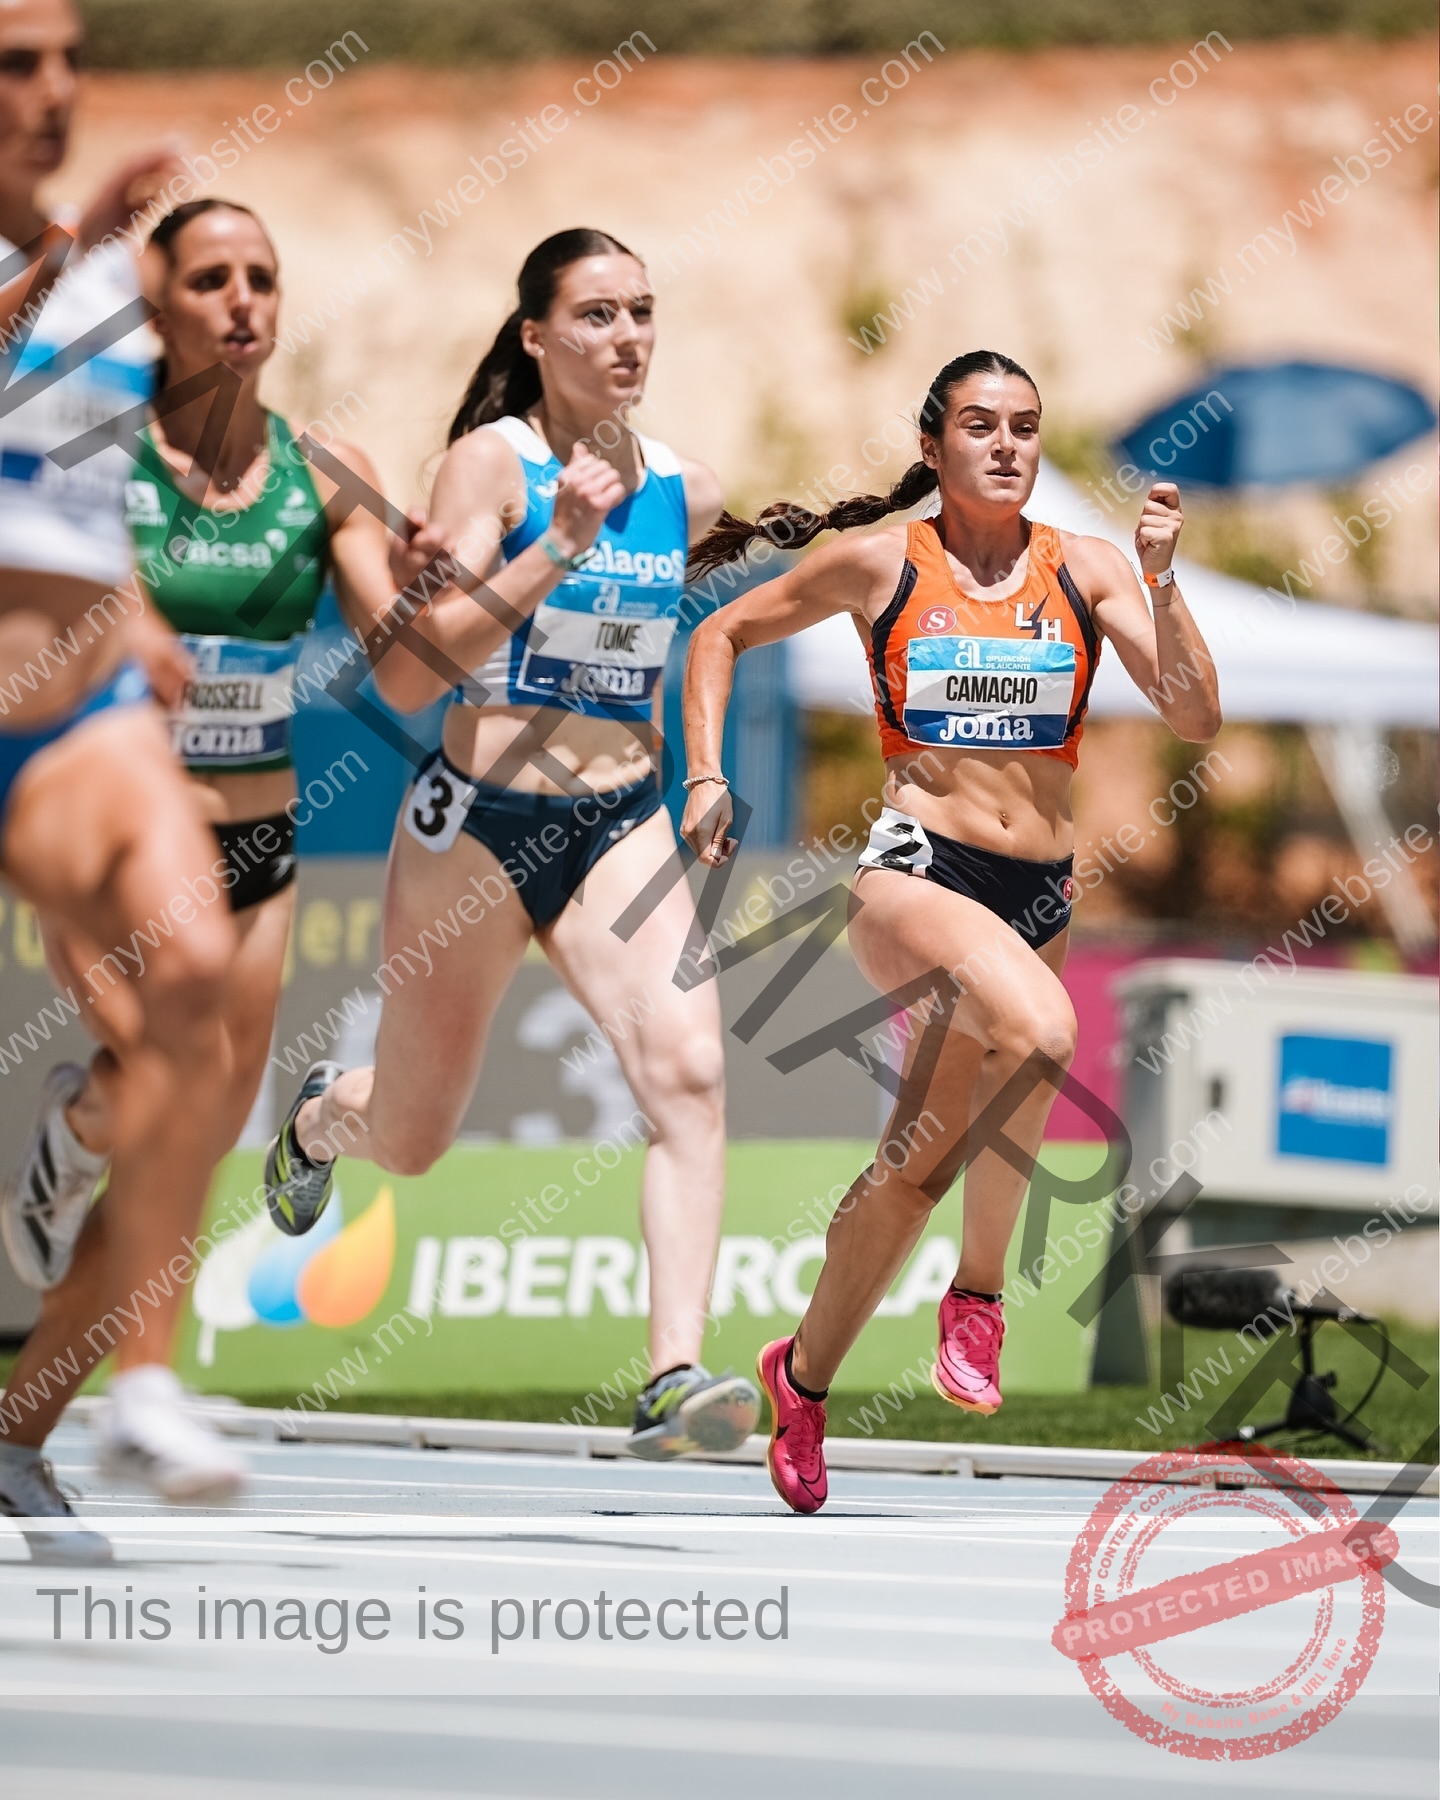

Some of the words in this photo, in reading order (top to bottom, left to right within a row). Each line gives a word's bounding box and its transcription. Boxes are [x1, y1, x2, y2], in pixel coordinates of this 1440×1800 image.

[595, 621, 641, 653] TOME
[986, 654, 1031, 663] DIPUTACIÓN
[997, 663, 1031, 671] ALICANTE
[945, 674, 1038, 705] CAMACHO
[413, 775, 454, 837] 3
[409, 1235, 959, 1318] IBERROA
